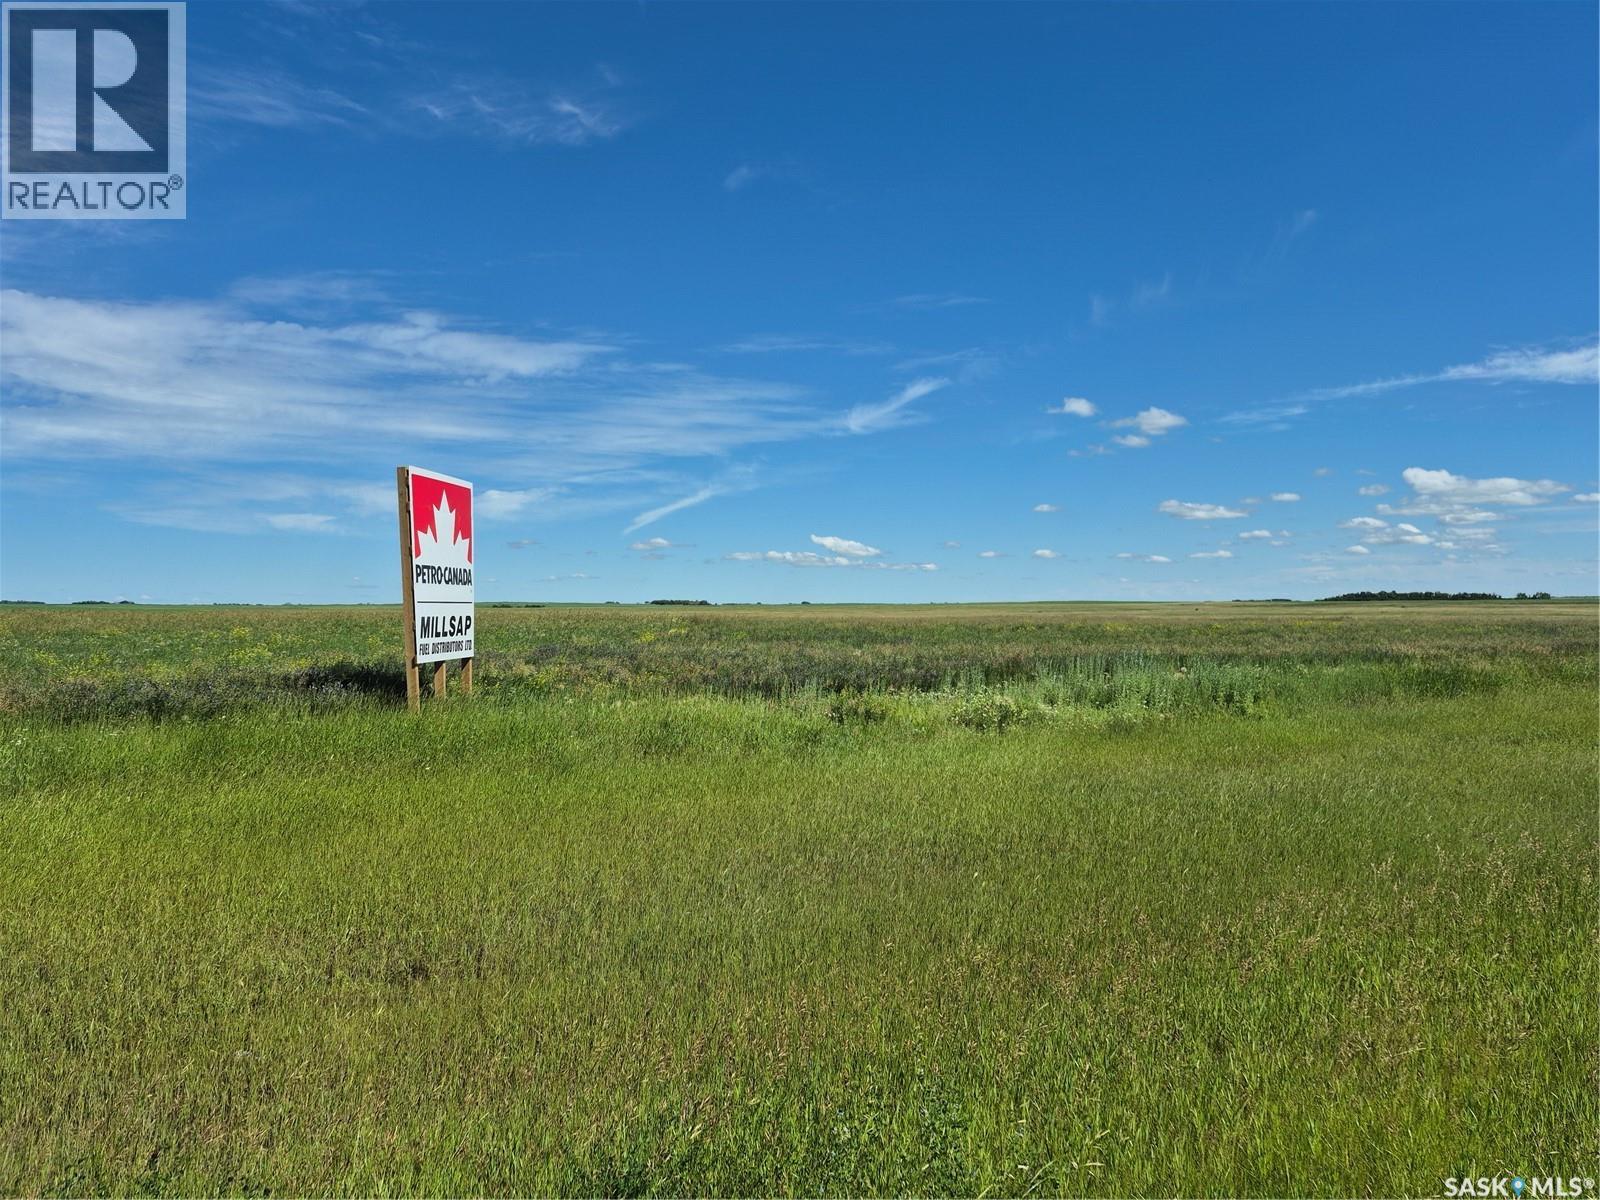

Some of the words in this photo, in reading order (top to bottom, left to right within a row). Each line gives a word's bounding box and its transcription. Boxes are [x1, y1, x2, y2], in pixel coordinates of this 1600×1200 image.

[420, 615, 472, 639] MILLSAP
[419, 643, 430, 656] FUEL
[431, 640, 464, 655] DISTRIBUTORS
